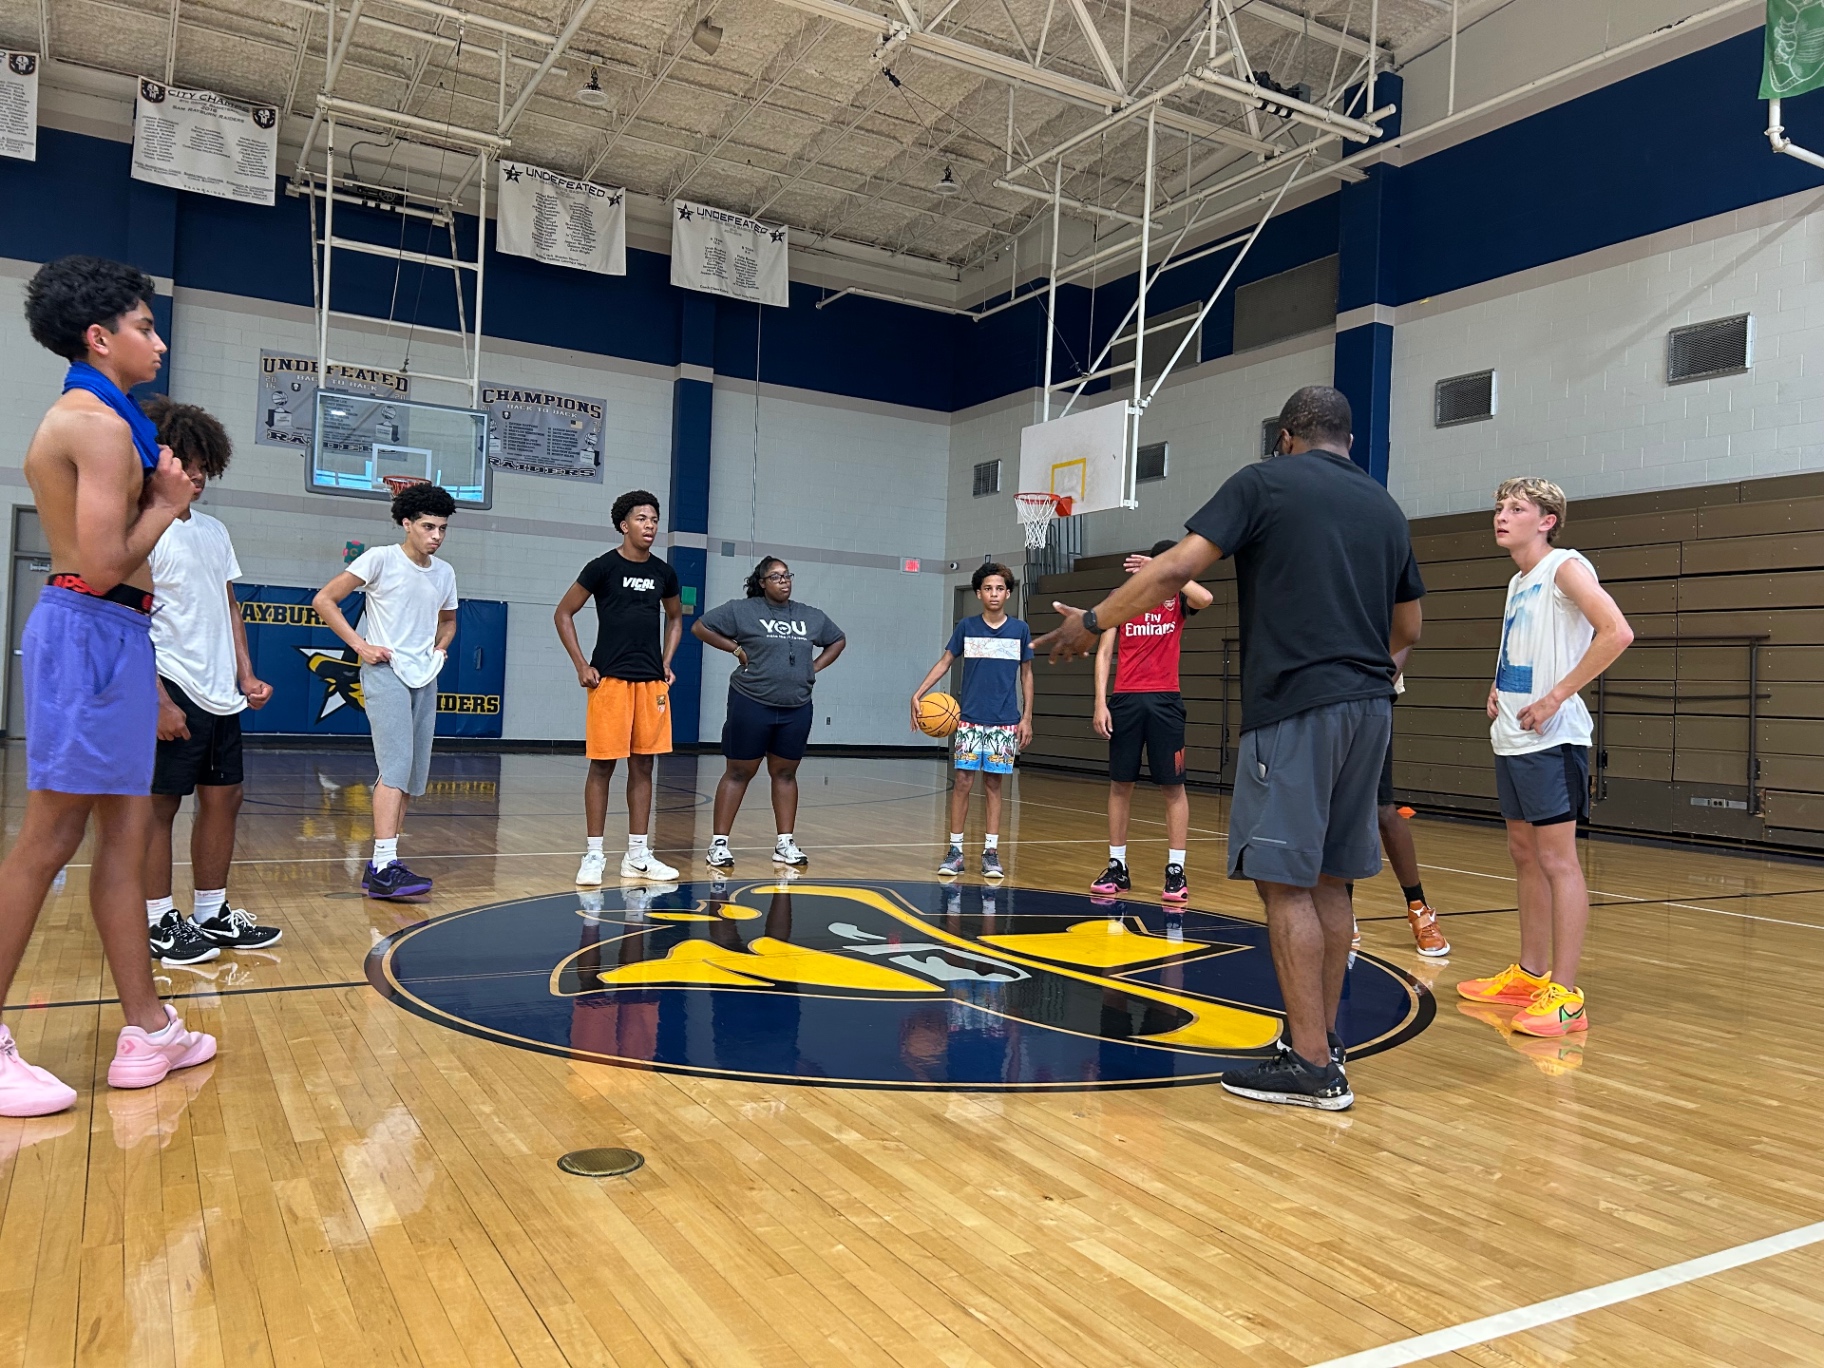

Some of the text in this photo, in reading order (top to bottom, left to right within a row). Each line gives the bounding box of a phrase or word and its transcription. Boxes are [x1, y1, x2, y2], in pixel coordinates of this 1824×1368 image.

[168, 89, 196, 99] CITY
[187, 107, 217, 118] RAYBURN
[218, 114, 245, 123] RAIDERS
[525, 166, 606, 198] UNDEFEATED
[696, 206, 769, 234] UNDEFEATED
[482, 389, 602, 419] CHAMPIONS
[237, 601, 341, 627] AYBUR
[1144, 613, 1162, 623] Fly
[759, 618, 807, 636] YOU
